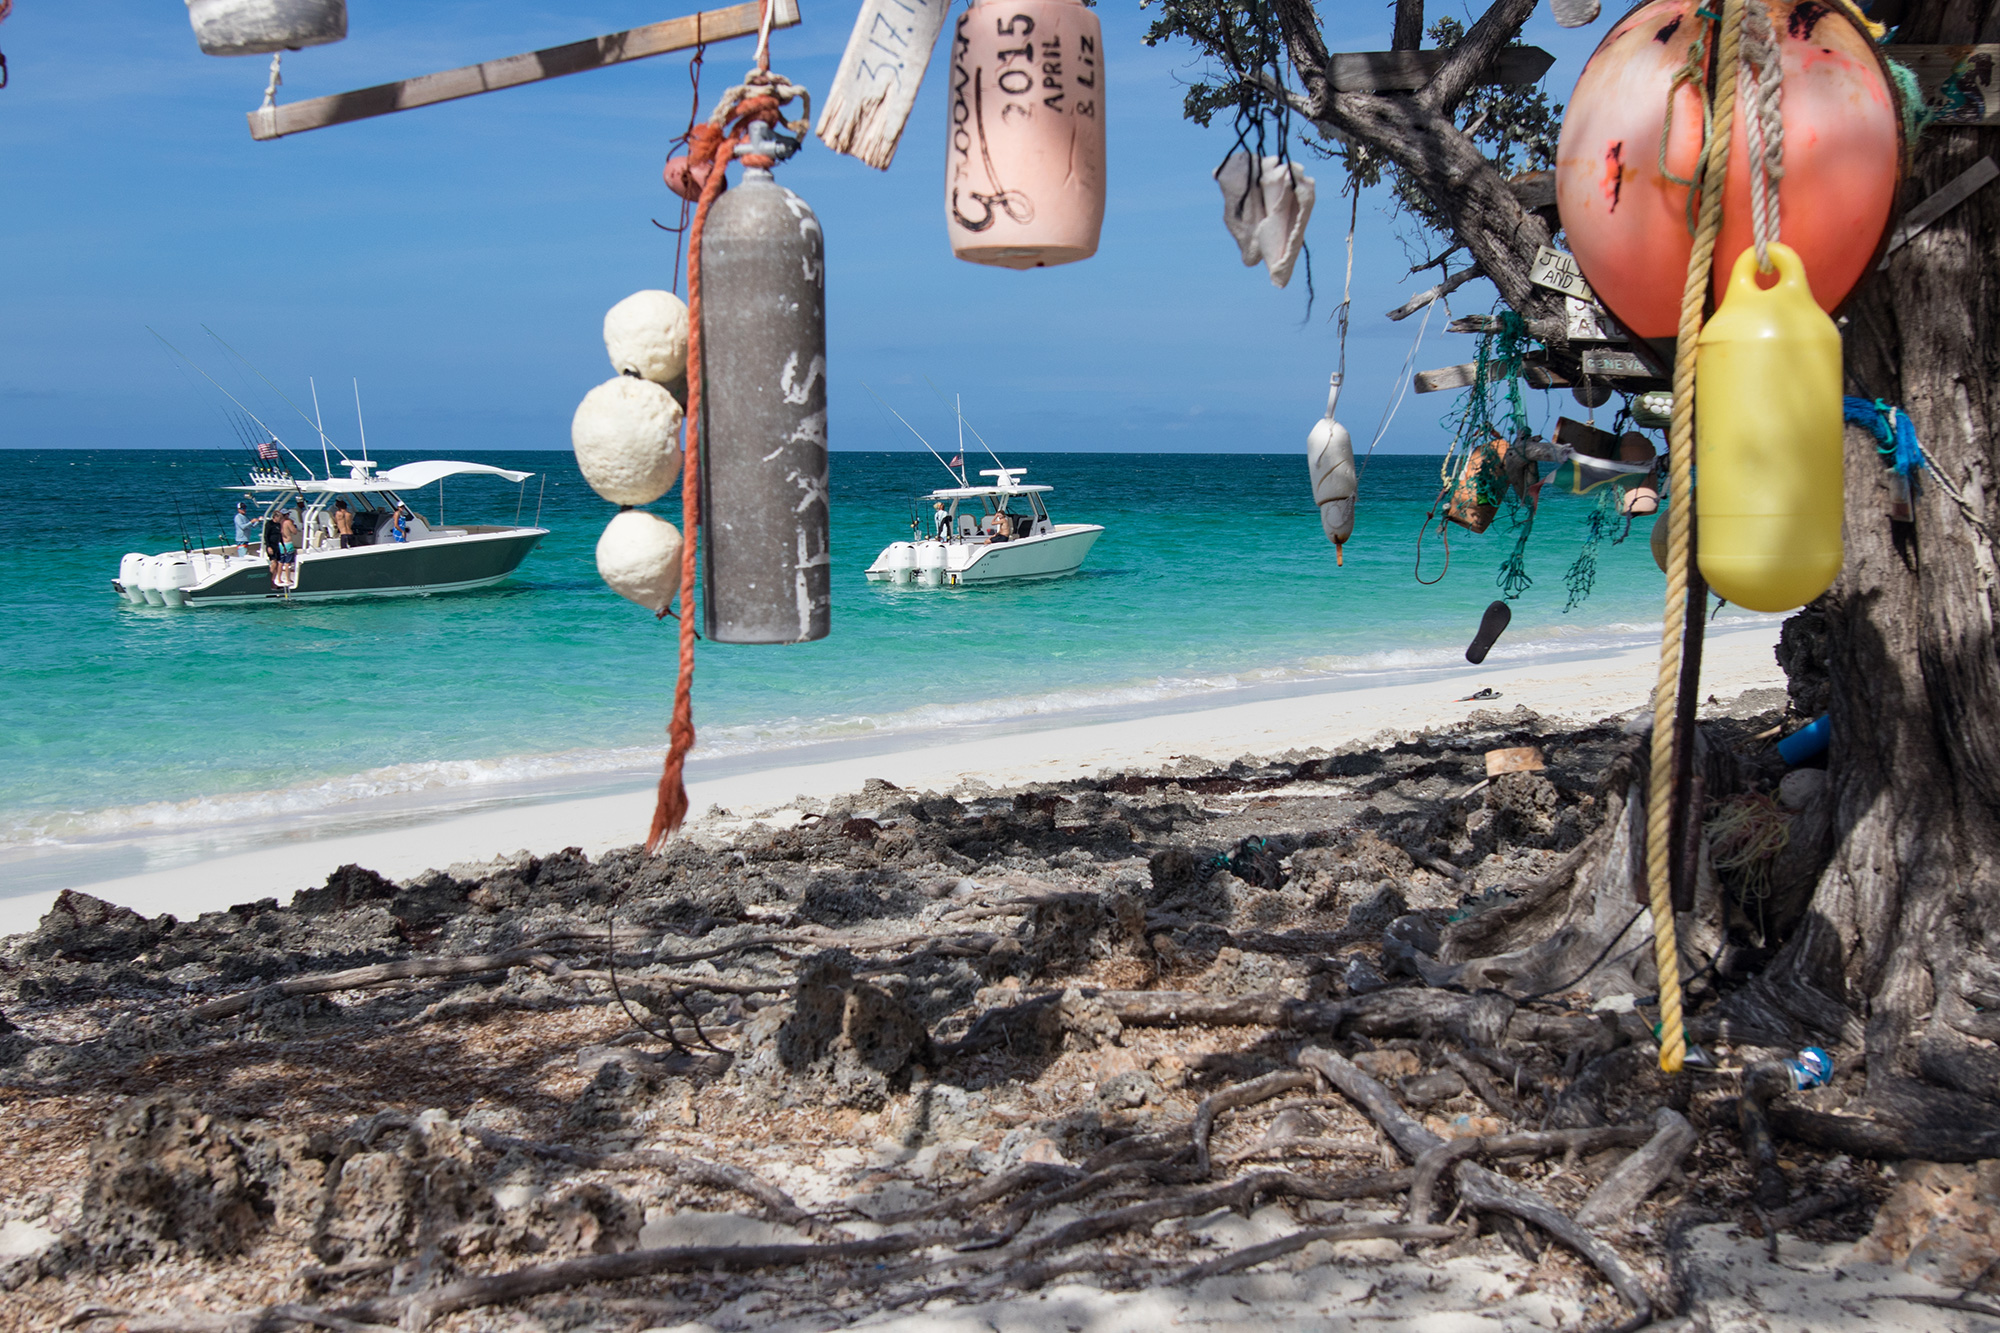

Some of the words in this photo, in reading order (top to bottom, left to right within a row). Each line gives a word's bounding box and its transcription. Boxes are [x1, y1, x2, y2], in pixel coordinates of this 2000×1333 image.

[997, 13, 1035, 125] 2015
[1042, 35, 1065, 113] APRIL
[1076, 101, 1095, 119] &
[1542, 269, 1574, 290] AND
[779, 350, 831, 639] TEXAS
